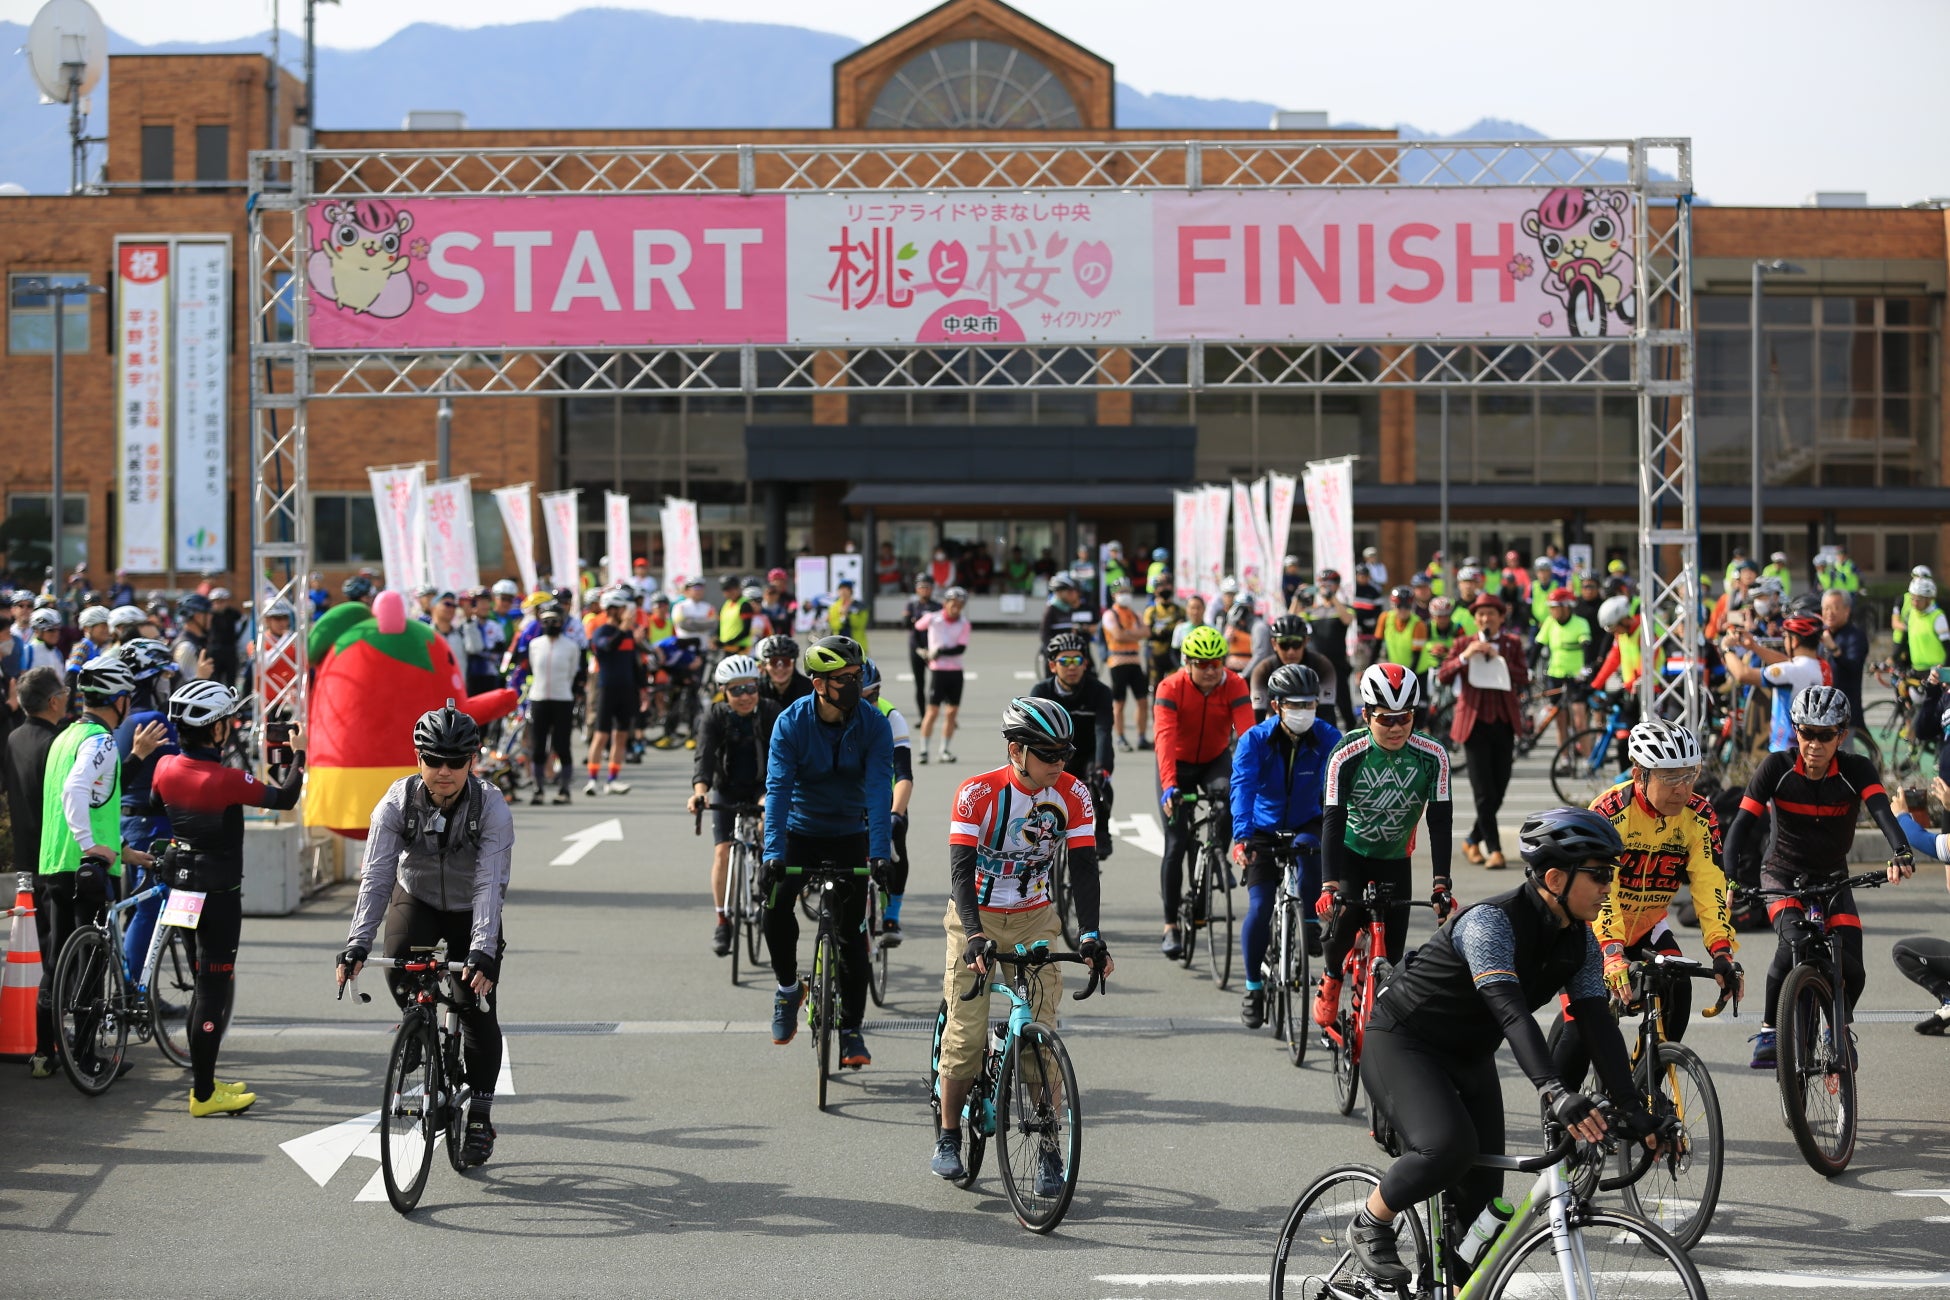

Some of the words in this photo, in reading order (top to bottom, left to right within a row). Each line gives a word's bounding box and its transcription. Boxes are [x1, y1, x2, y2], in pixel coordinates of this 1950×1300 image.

[848, 203, 1091, 222] リニアライドやまなし中央
[129, 249, 159, 279] 祝
[425, 229, 763, 314] START
[1177, 222, 1516, 306] FINISH
[944, 315, 999, 333] 中央市
[1040, 309, 1122, 329] サイクリング
